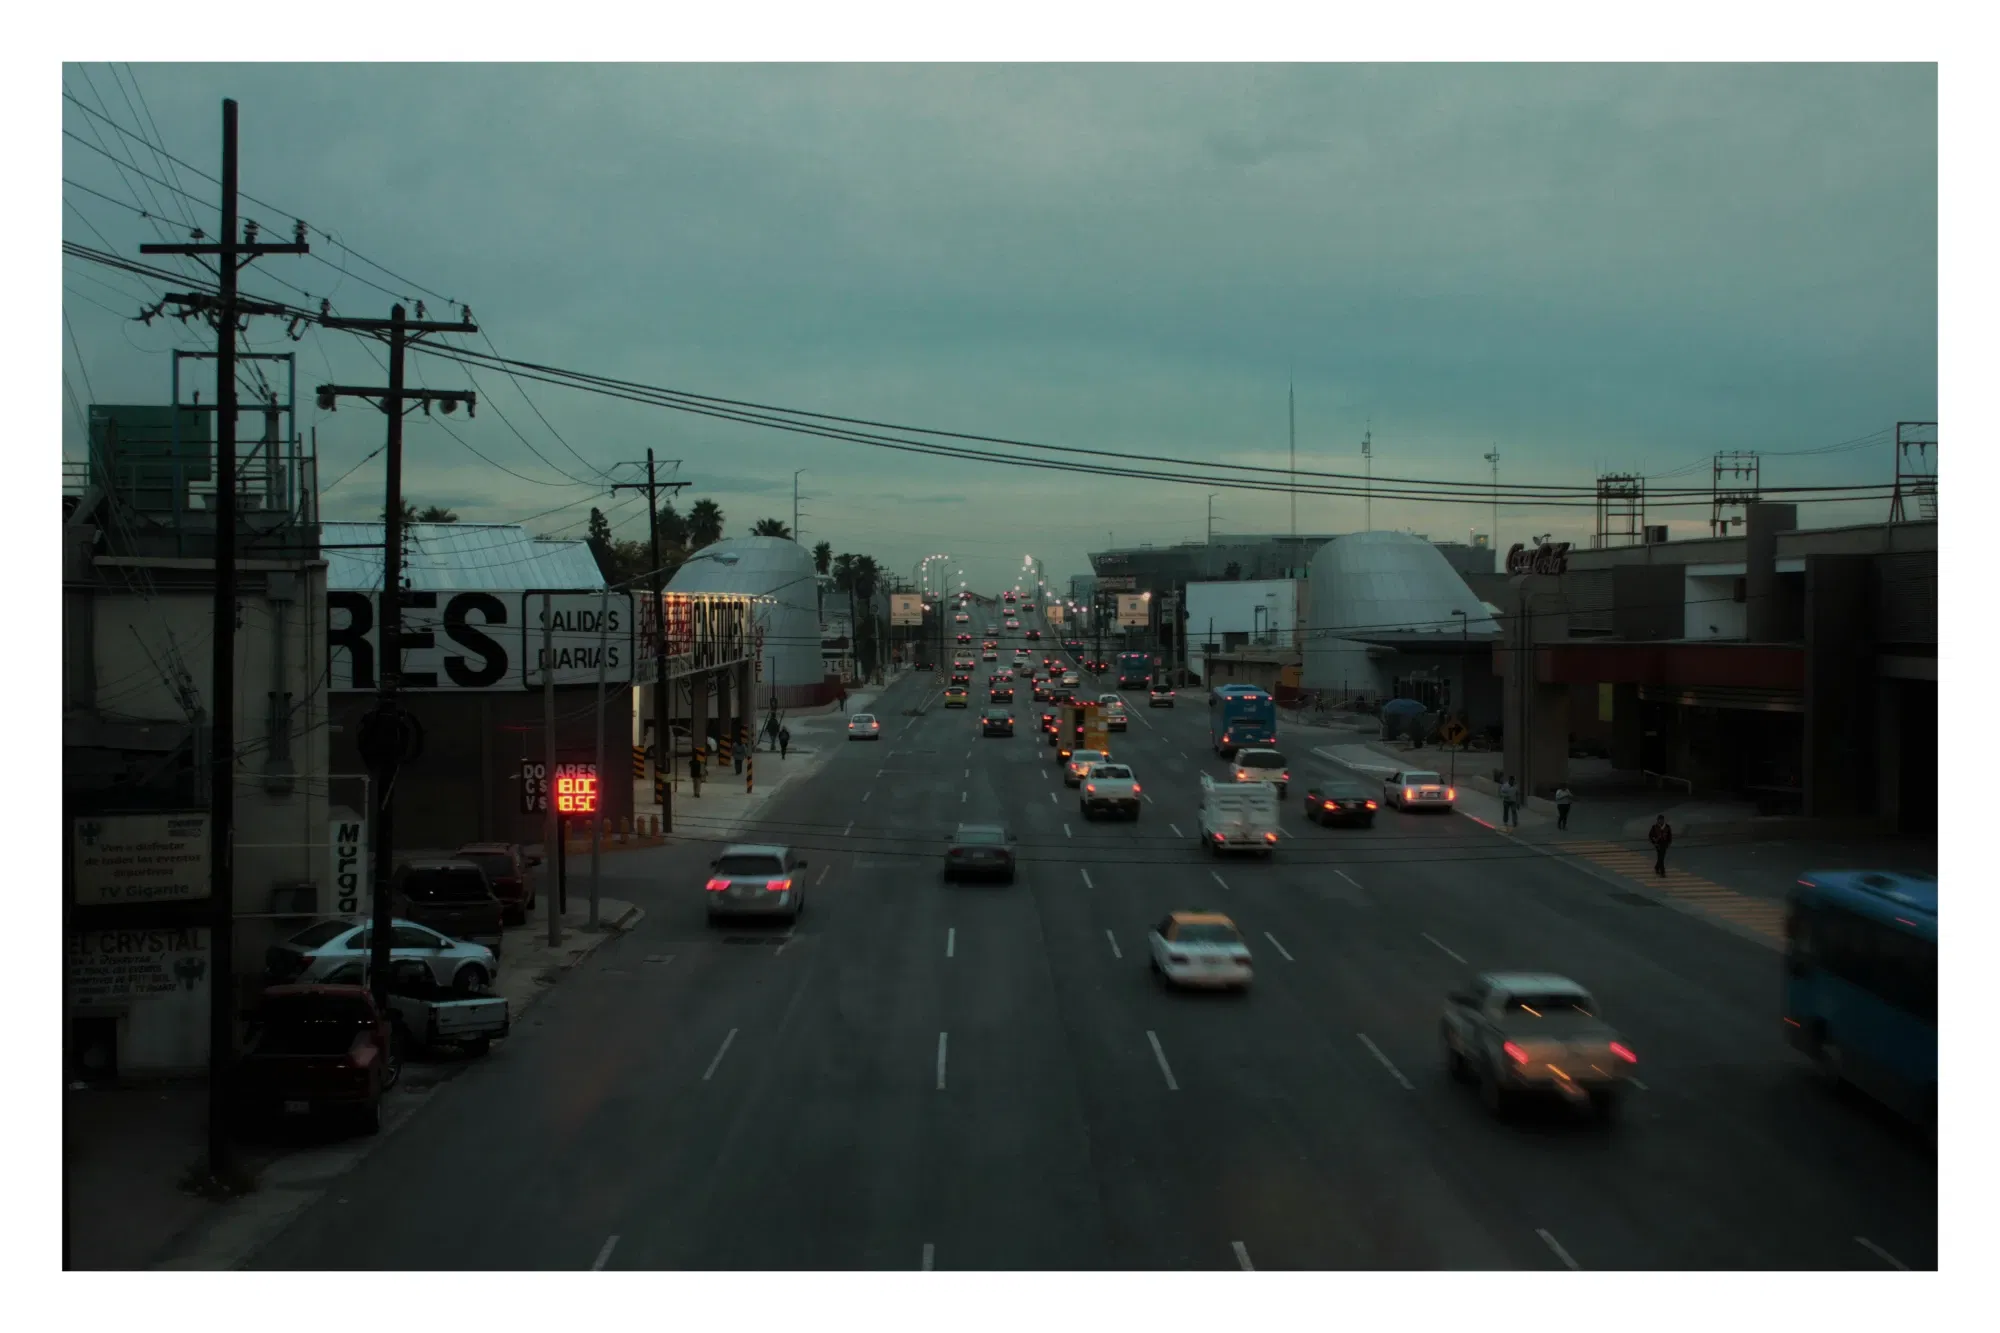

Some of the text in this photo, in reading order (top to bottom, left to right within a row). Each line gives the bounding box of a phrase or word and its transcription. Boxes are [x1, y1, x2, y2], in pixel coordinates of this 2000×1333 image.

[523, 764, 597, 779] DOARES
[100, 884, 189, 899] TV Gigante
[69, 929, 207, 955] EL CRYSTAL
